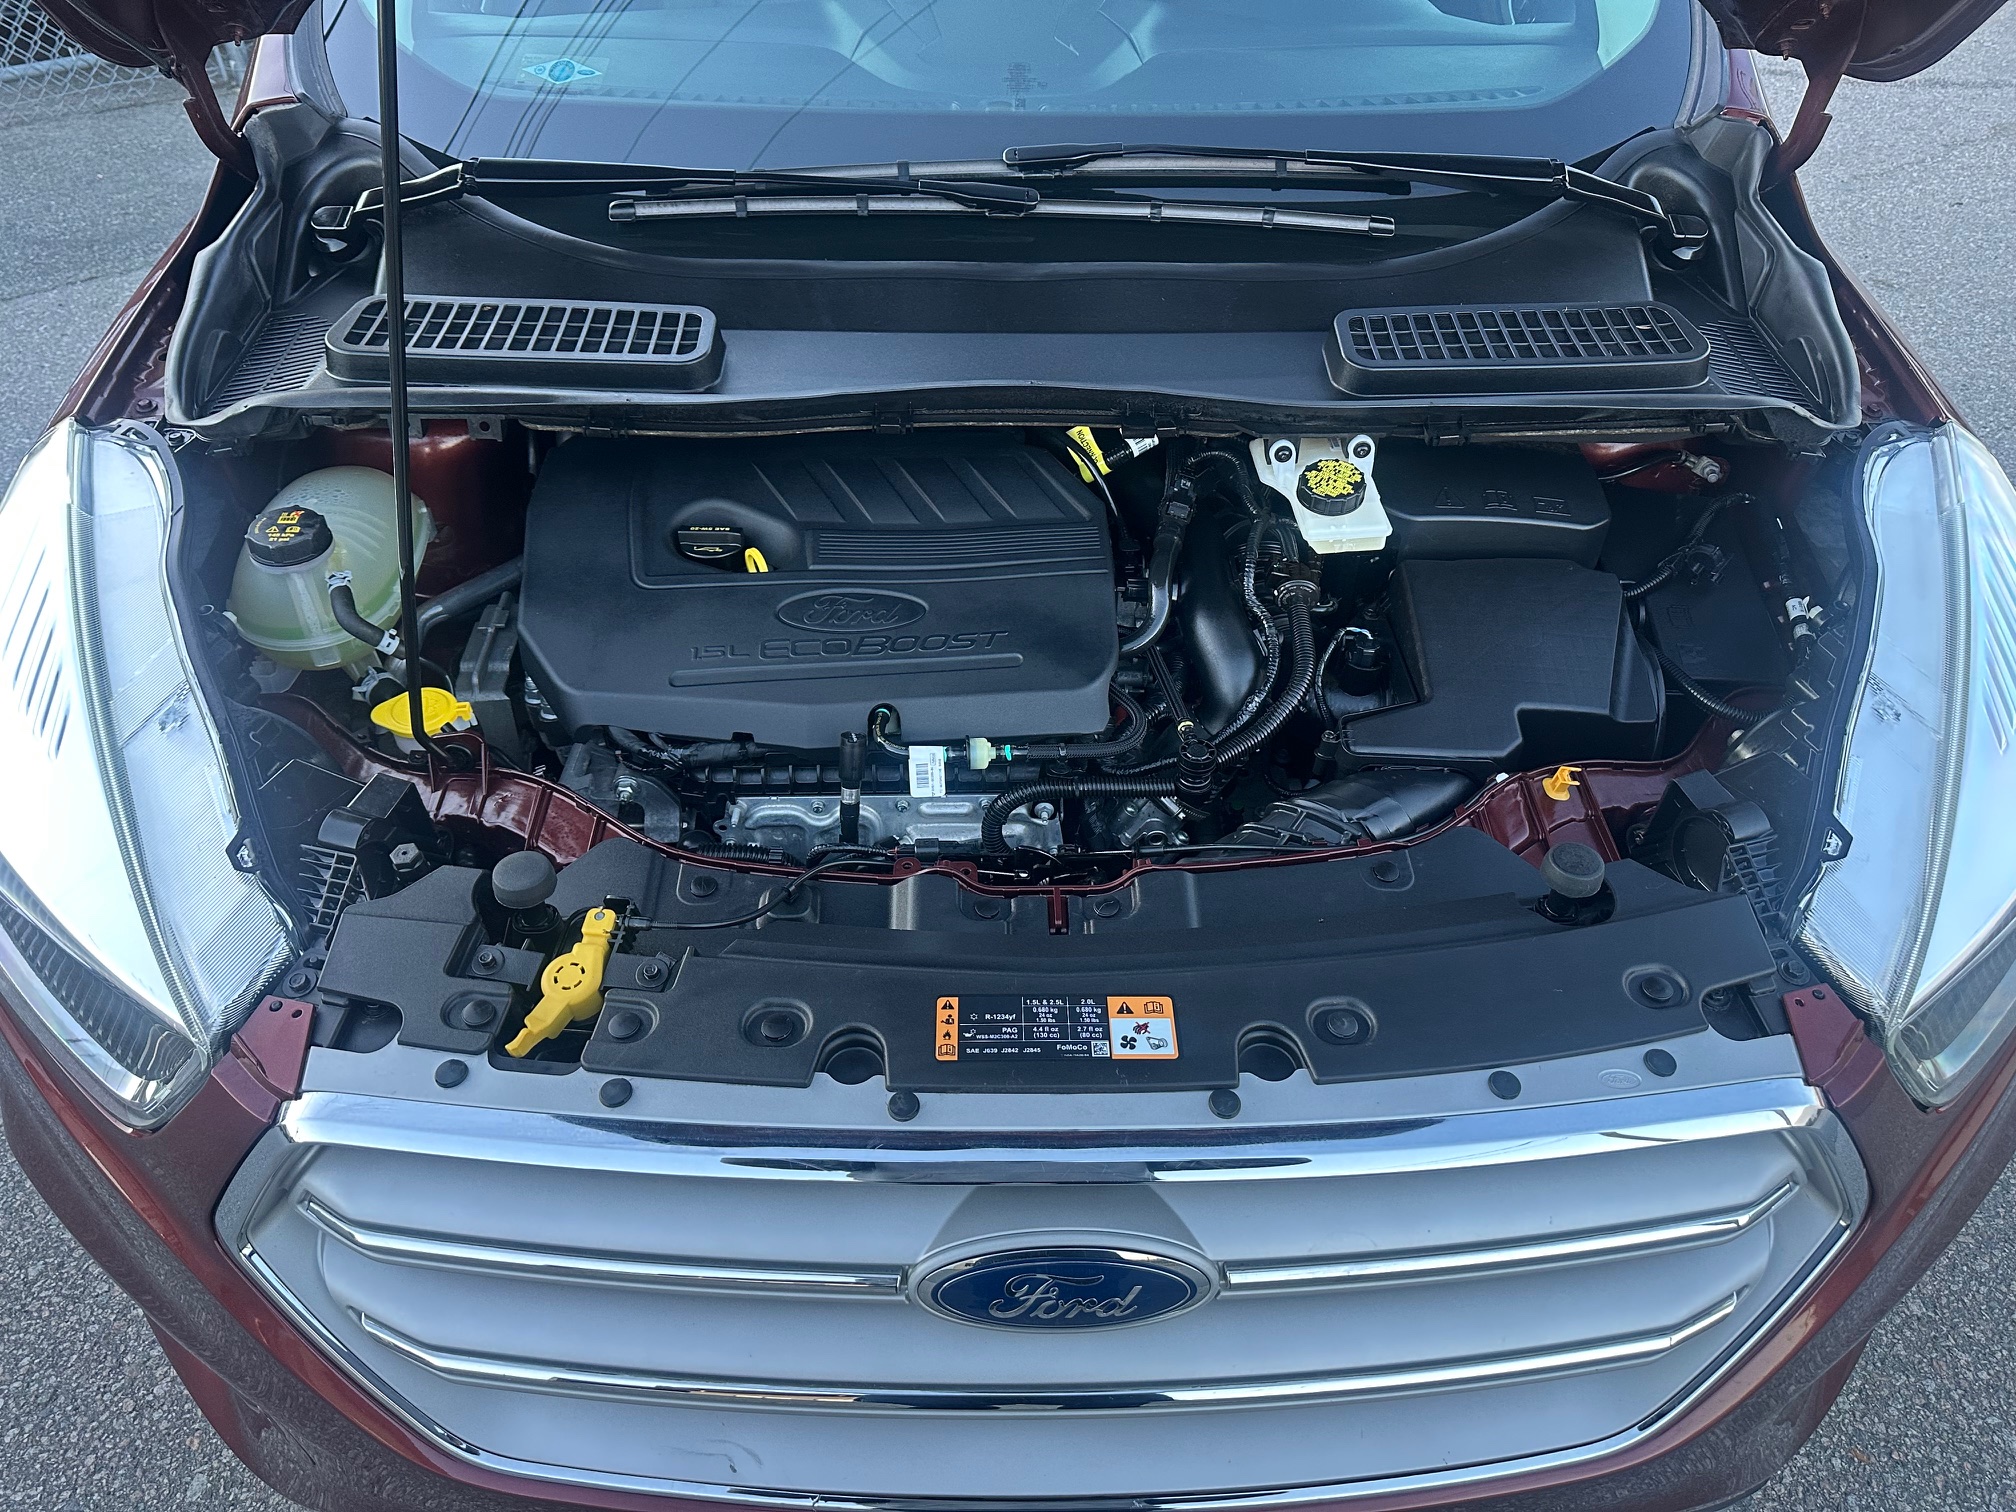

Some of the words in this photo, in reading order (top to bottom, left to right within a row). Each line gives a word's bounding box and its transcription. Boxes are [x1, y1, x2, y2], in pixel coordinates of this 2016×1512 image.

[803, 595, 899, 625] Ford
[1049, 1006, 1059, 1014] kg
[1093, 1006, 1102, 1014] kg
[985, 1013, 1016, 1021] R-1234yf
[989, 1273, 1143, 1319] Ford
